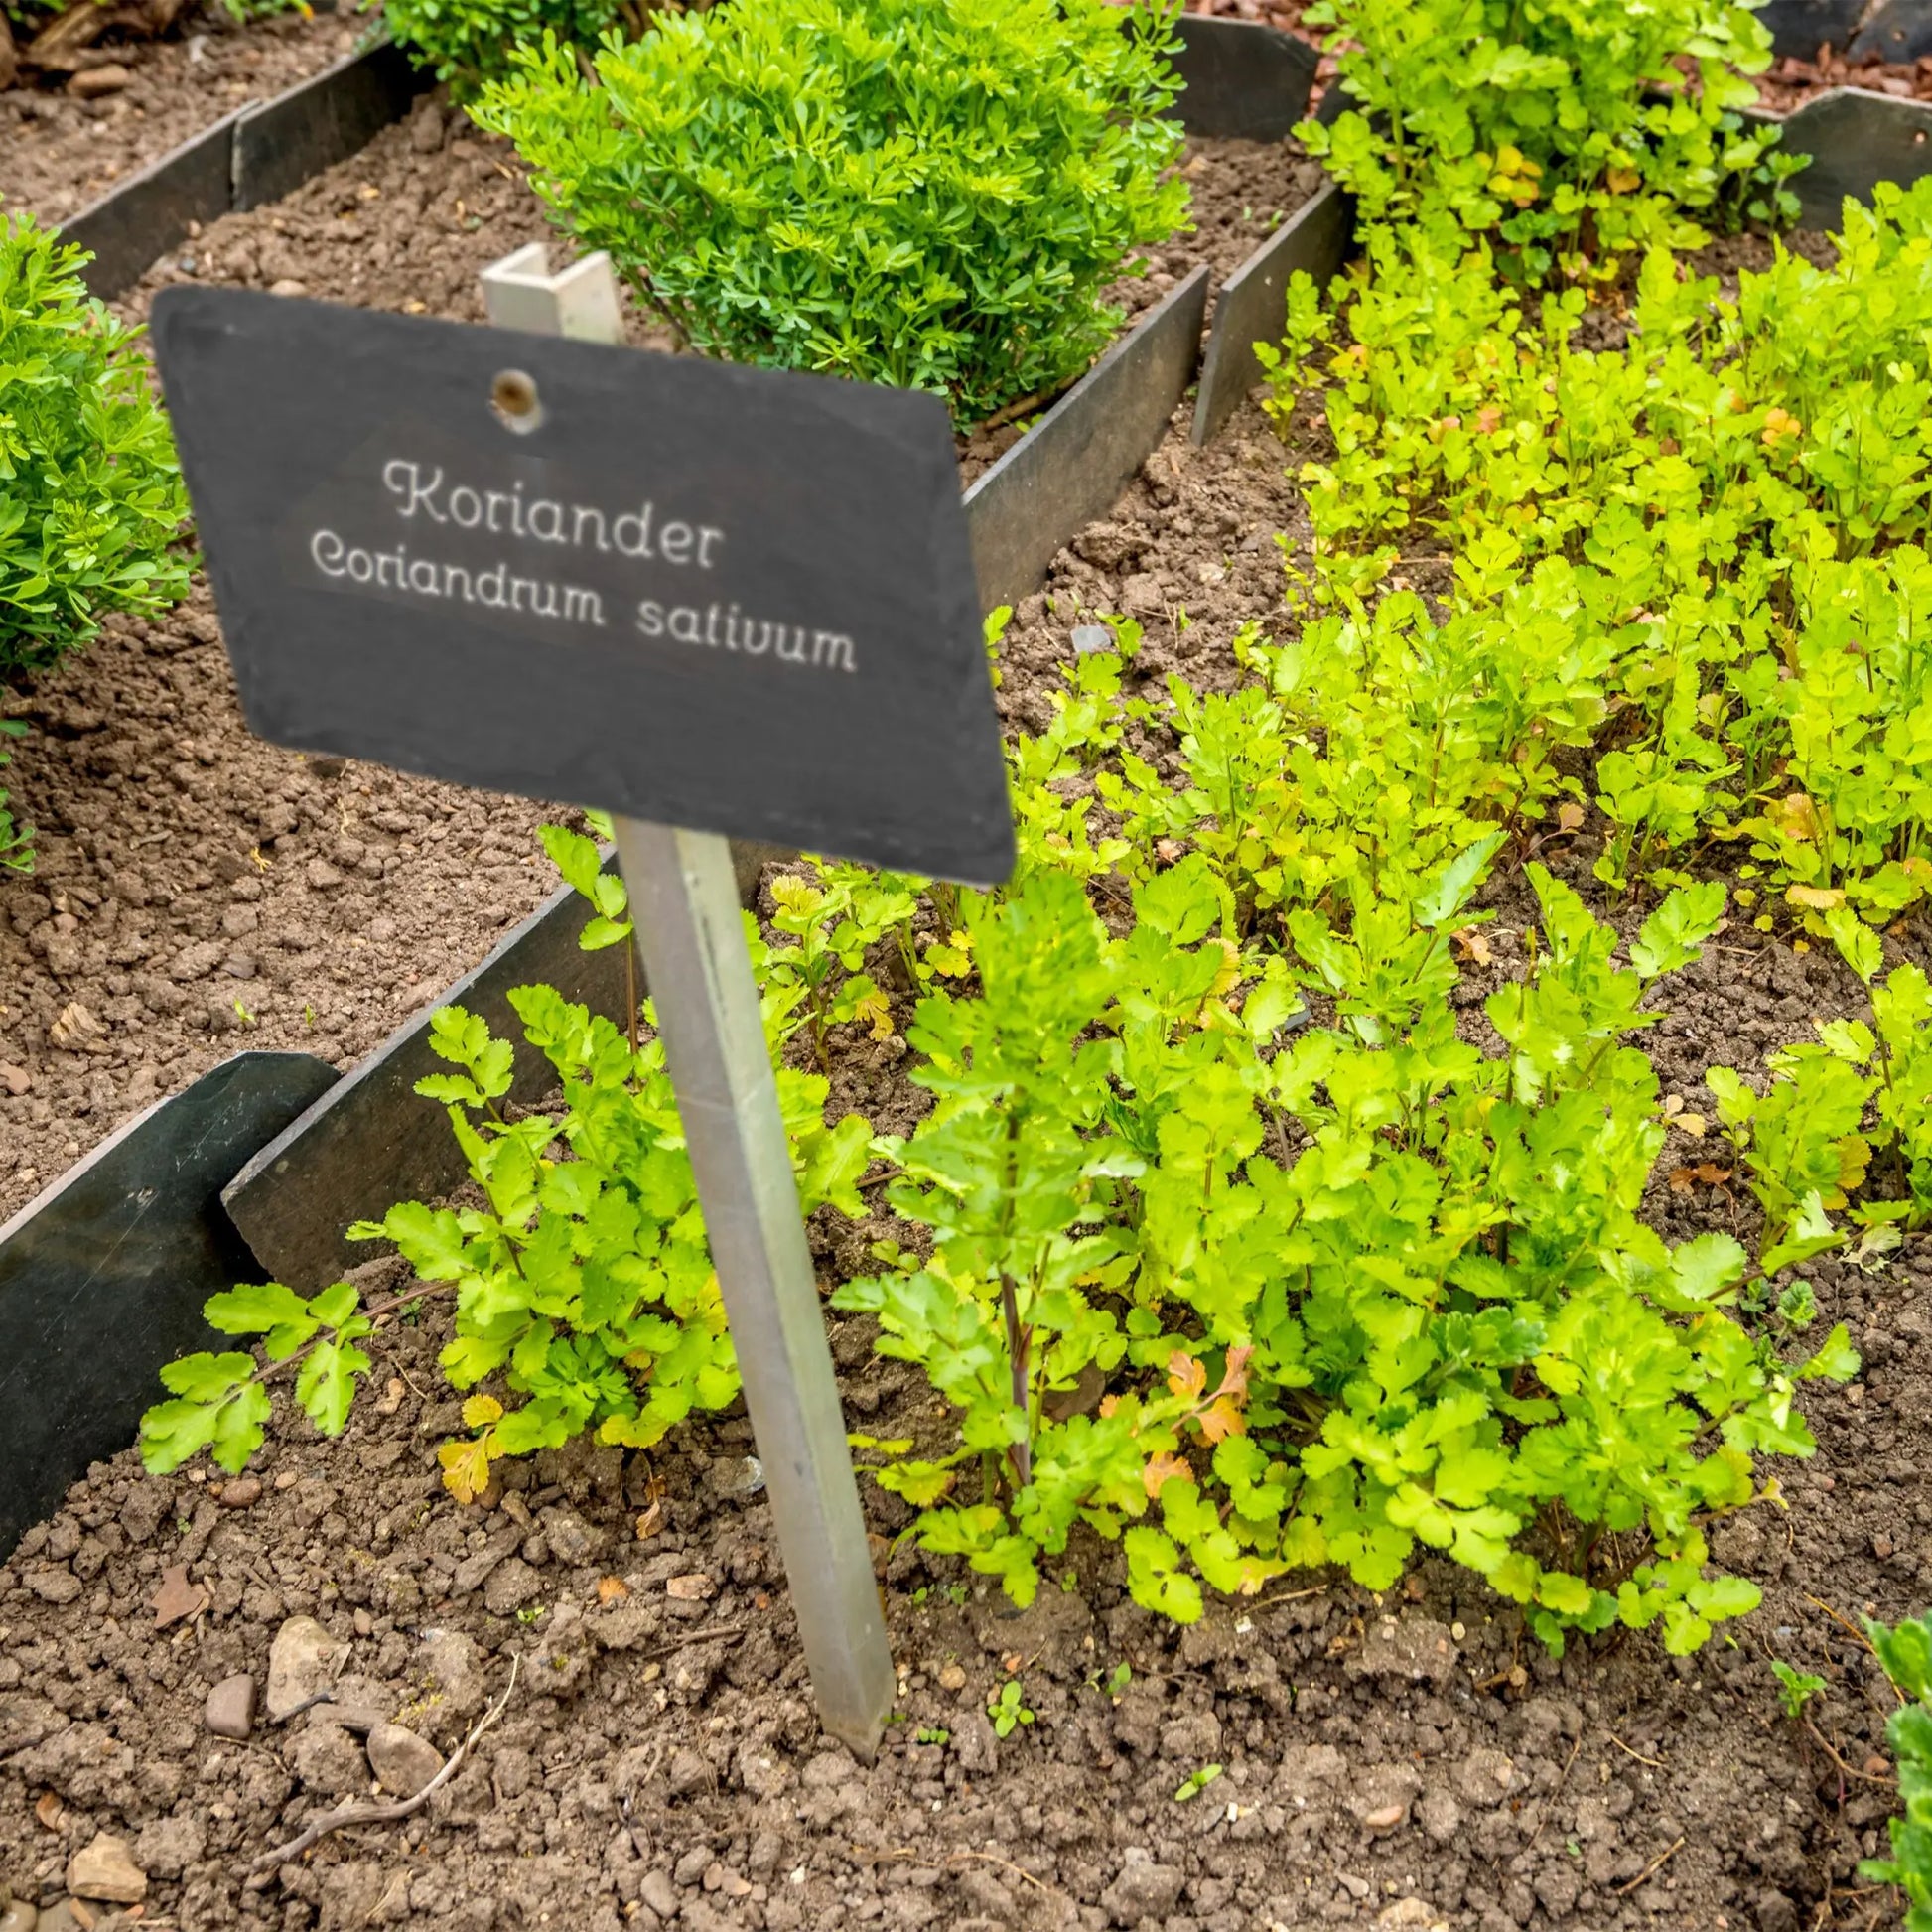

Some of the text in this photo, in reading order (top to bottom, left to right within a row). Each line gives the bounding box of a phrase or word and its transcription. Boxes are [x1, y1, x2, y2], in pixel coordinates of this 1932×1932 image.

[381, 459, 725, 570] Koriander
[310, 528, 858, 672] Coriandrum sativum
